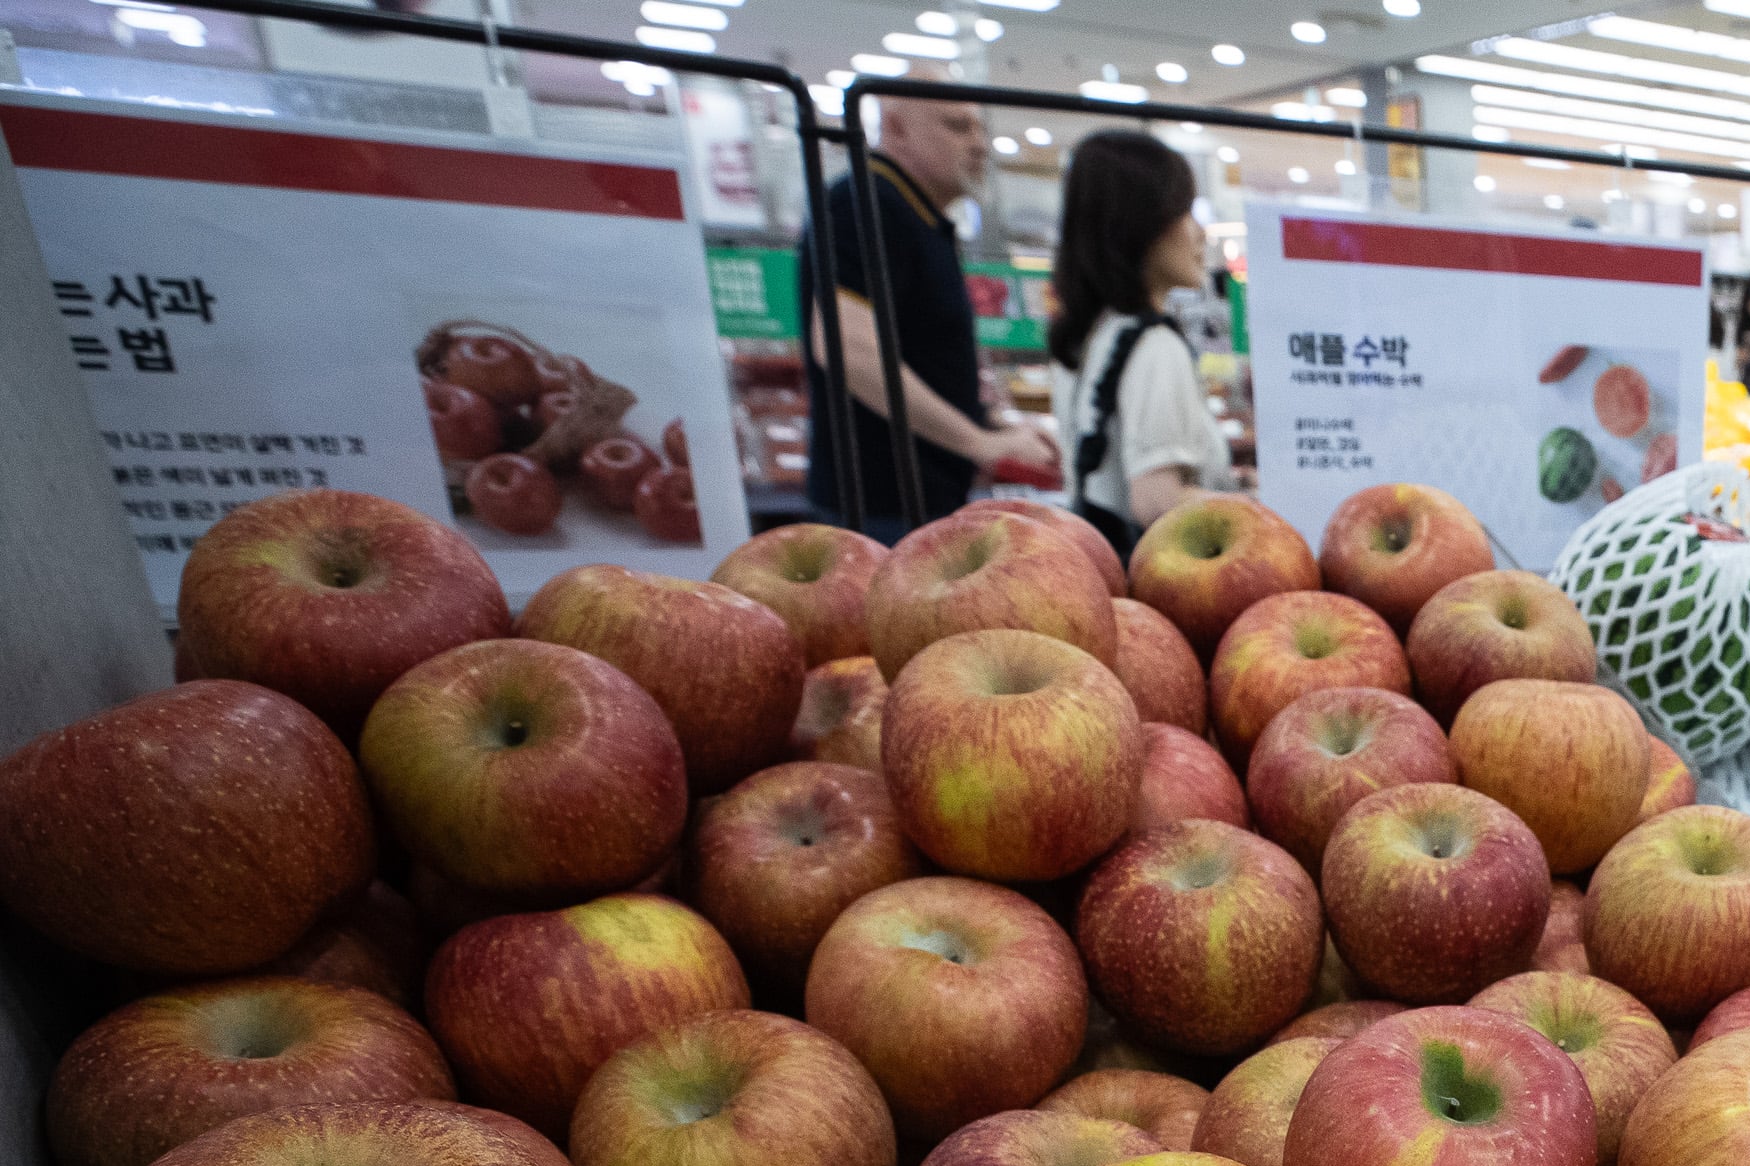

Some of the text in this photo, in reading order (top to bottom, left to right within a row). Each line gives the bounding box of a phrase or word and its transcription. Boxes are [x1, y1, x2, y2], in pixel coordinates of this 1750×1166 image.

[105, 274, 216, 323] 사과
[117, 328, 176, 374] 법
[1288, 331, 1409, 368] 애플 수박
